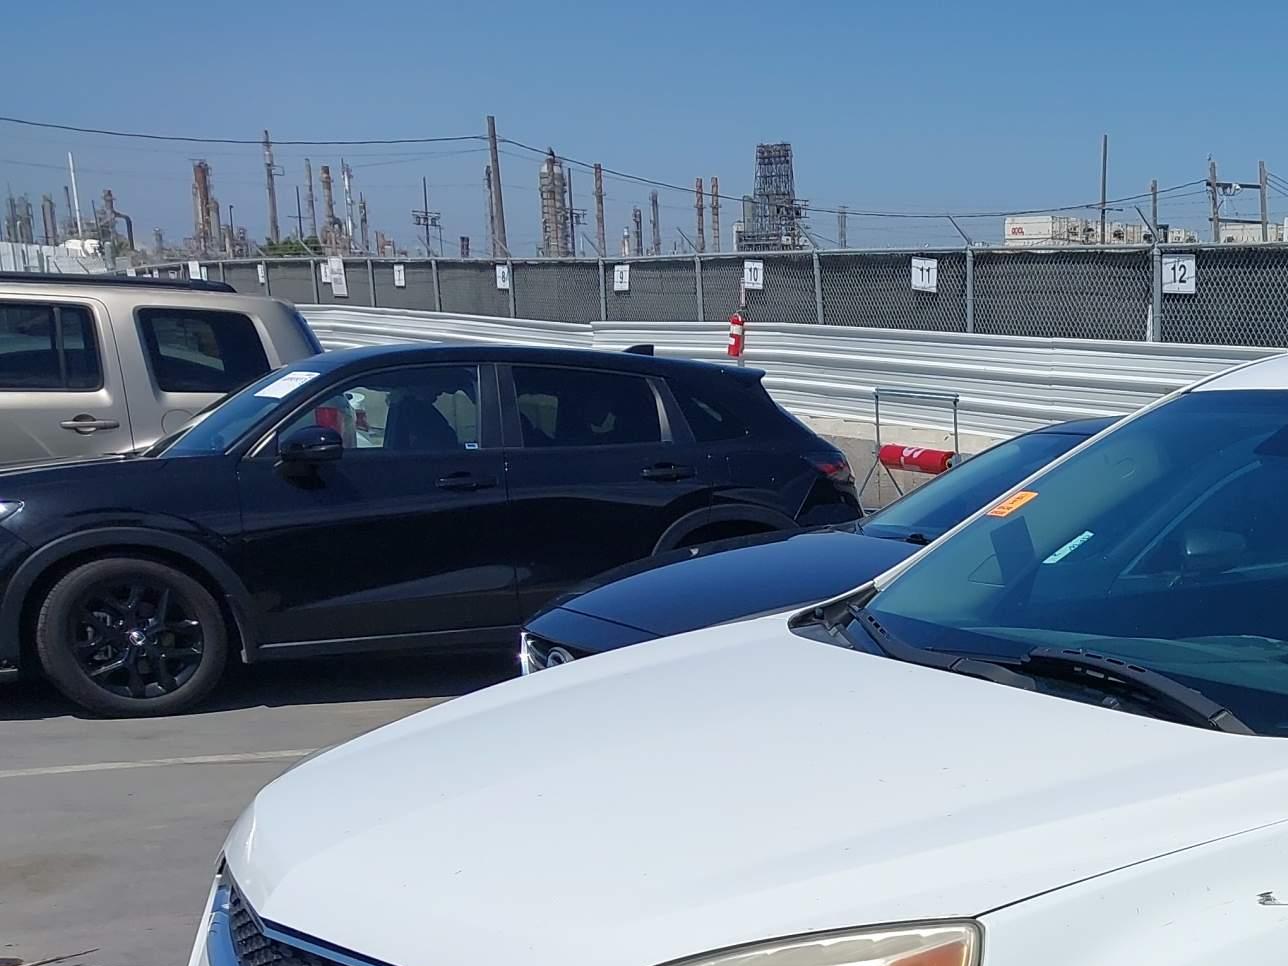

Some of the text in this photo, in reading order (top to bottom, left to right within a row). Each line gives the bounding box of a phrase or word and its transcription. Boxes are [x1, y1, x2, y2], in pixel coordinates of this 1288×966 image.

[501, 271, 506, 283] 8
[619, 271, 624, 284] 9
[749, 267, 759, 282] 10
[919, 266, 931, 284] 11
[1171, 263, 1187, 284] 12
